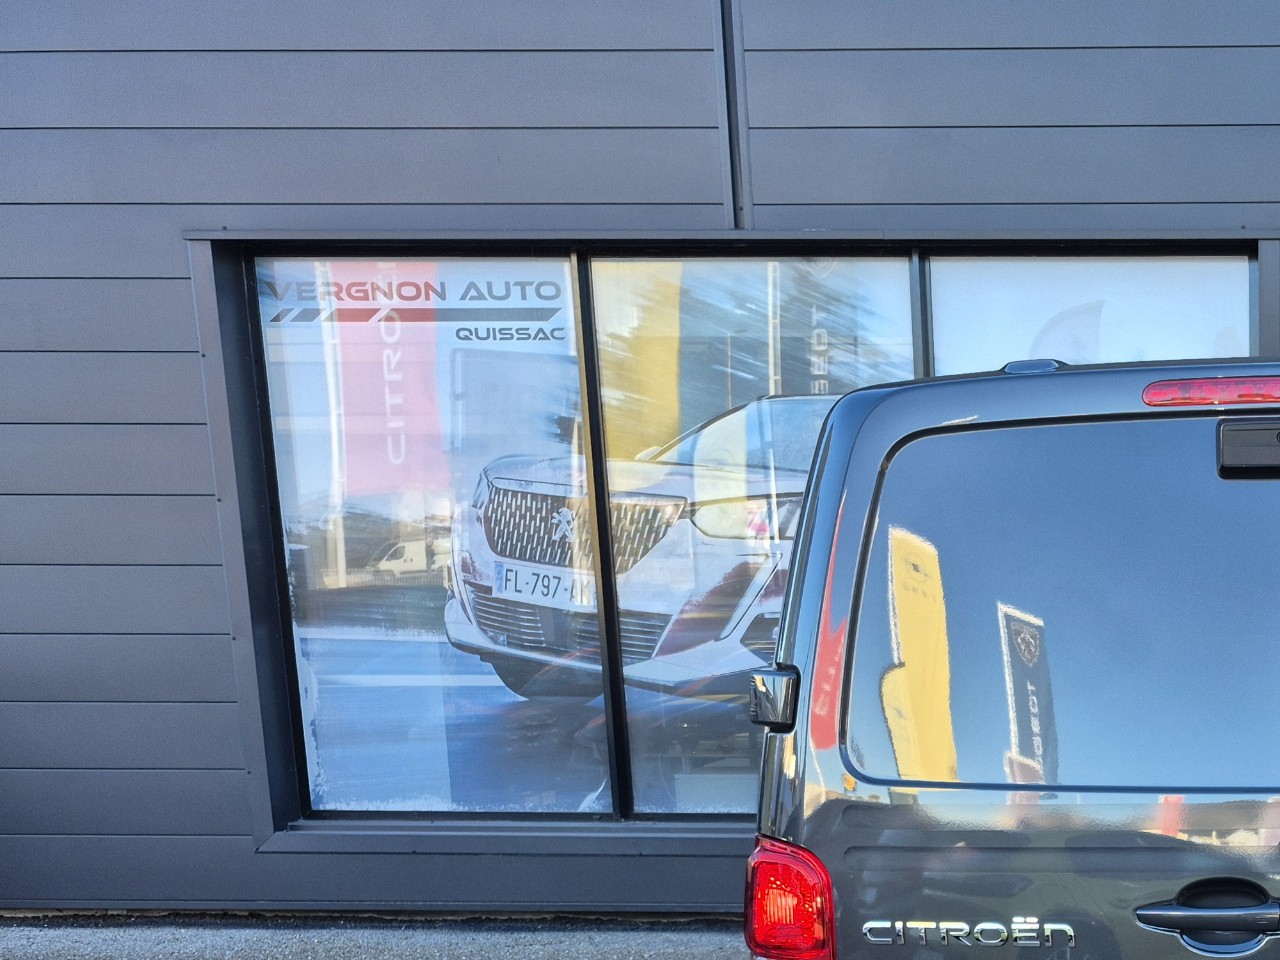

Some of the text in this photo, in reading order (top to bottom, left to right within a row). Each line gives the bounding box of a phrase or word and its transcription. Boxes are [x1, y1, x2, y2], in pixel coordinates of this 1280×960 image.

[265, 280, 562, 301] VERGNON AUTO
[455, 327, 566, 341] QUISSAC
